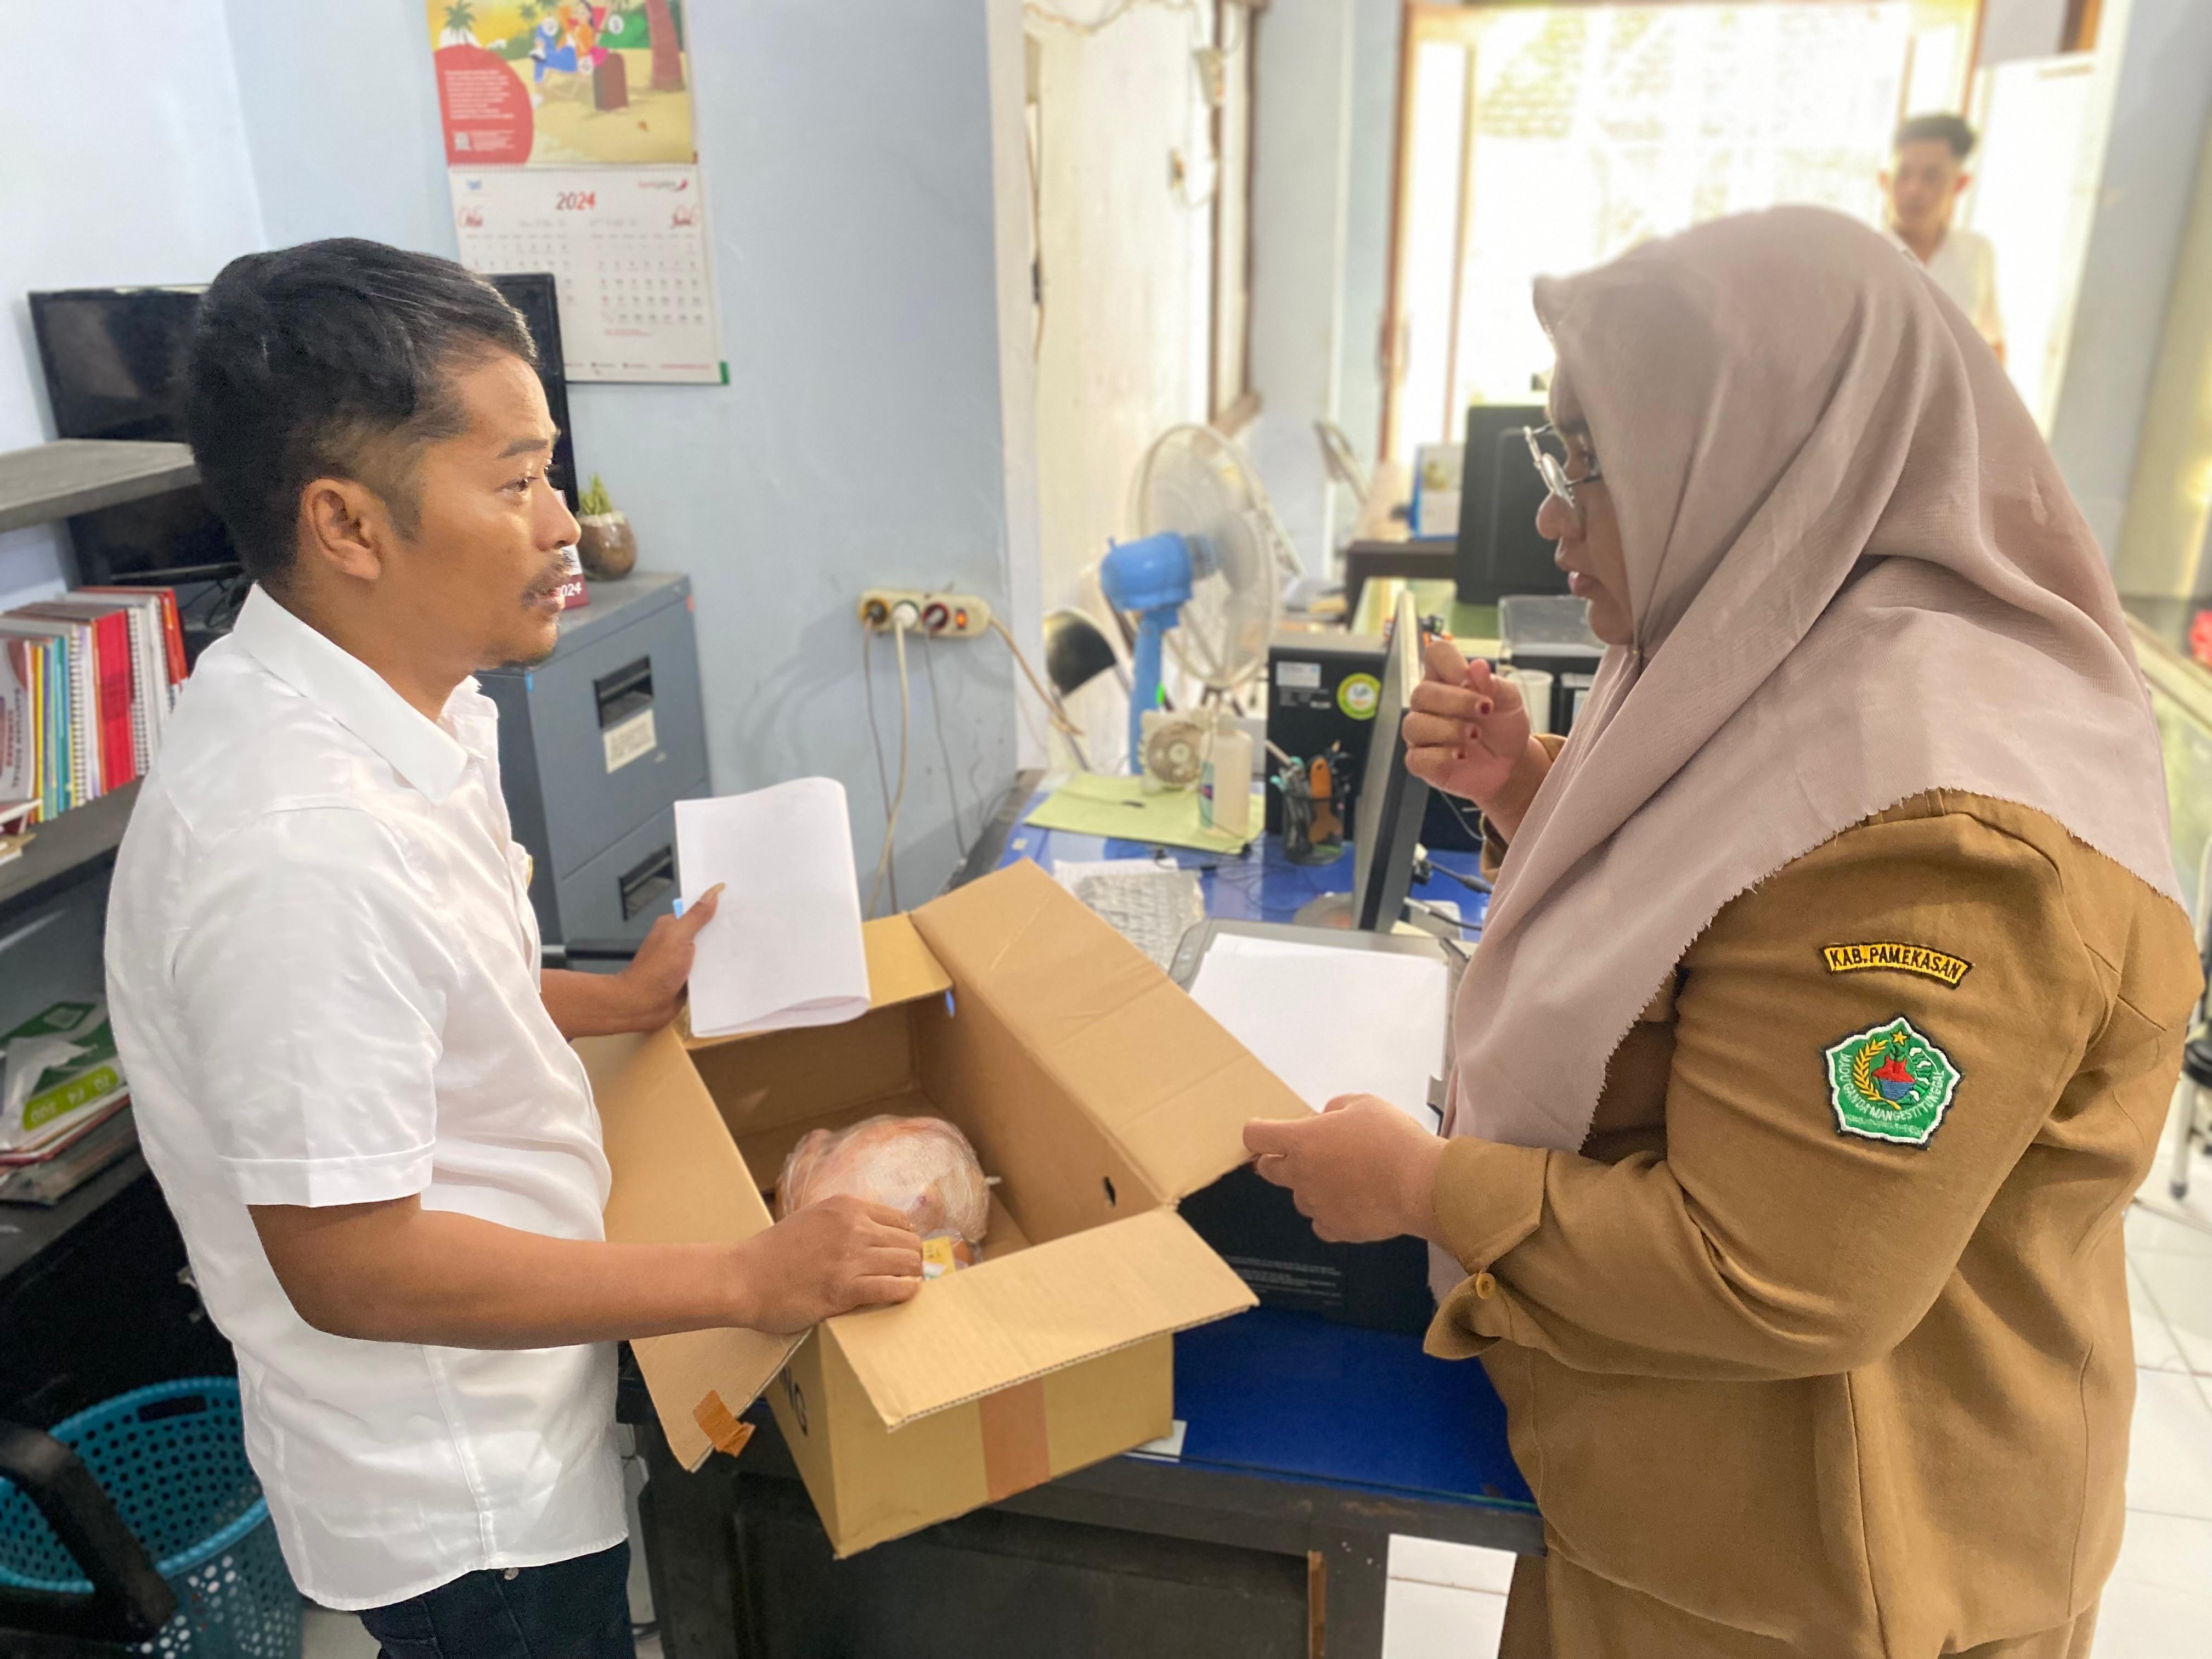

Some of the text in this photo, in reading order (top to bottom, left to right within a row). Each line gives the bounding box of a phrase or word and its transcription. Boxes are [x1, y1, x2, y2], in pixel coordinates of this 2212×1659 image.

[556, 191, 596, 211] 2024
[1838, 1053, 1852, 1082] MADU
[1843, 1083, 1870, 1115] GANDA
